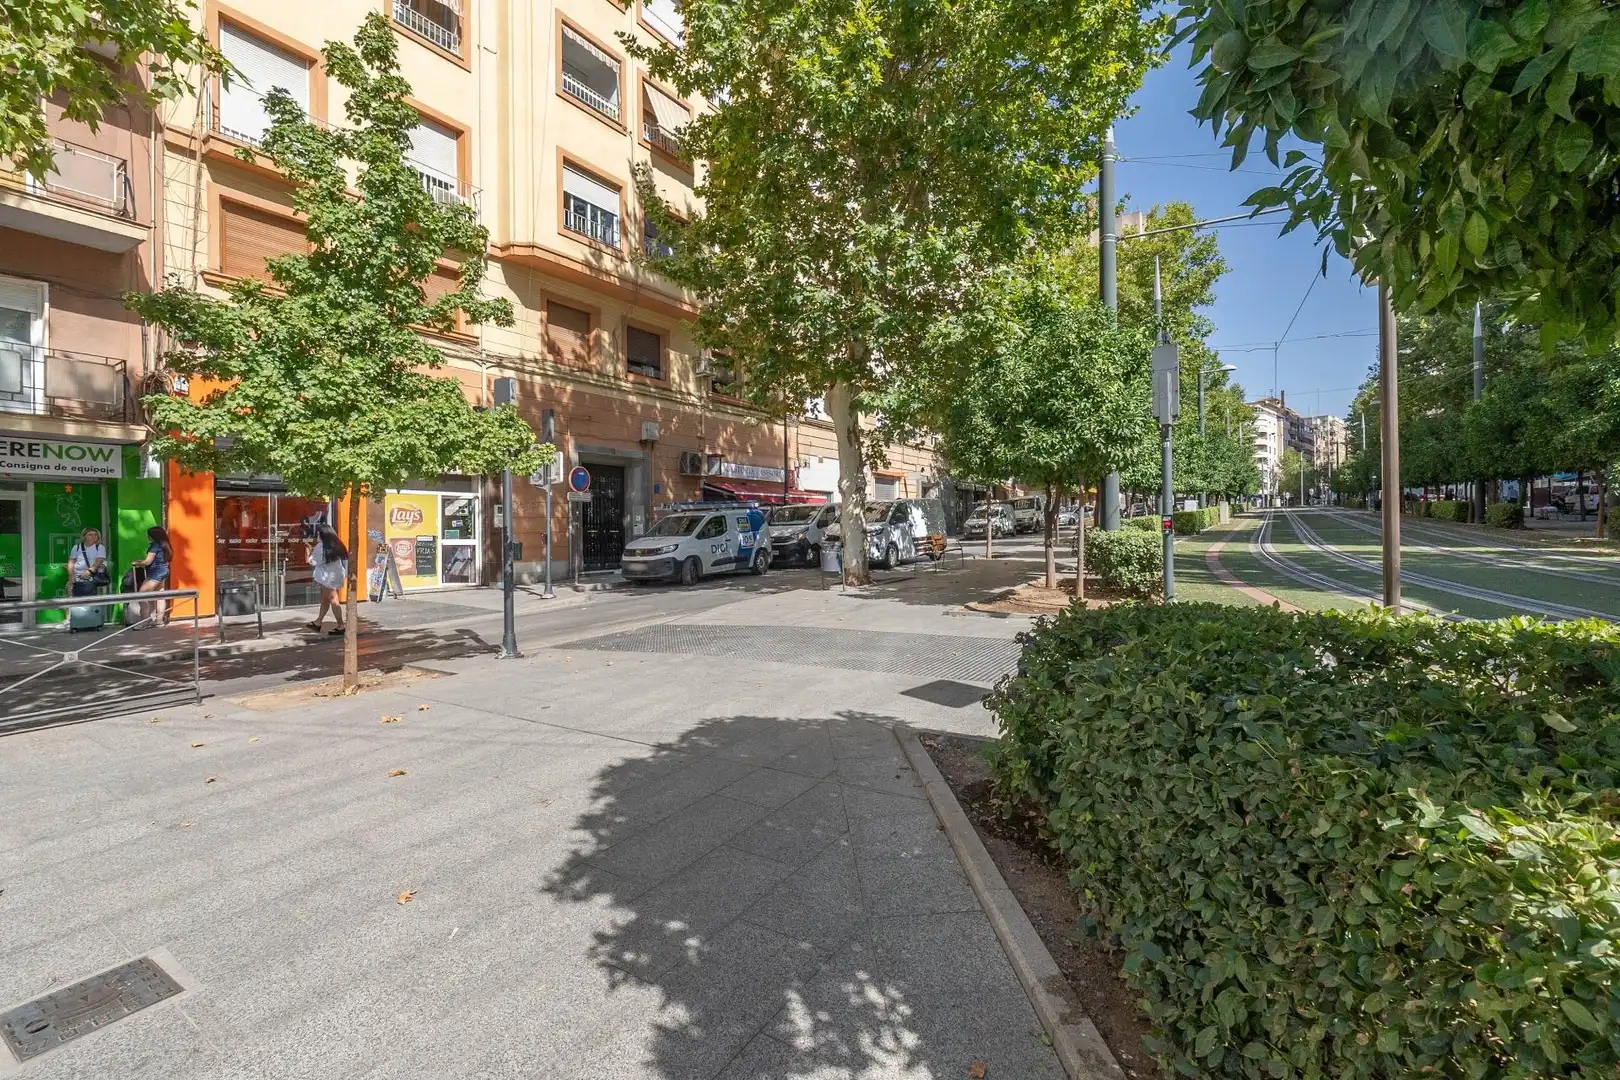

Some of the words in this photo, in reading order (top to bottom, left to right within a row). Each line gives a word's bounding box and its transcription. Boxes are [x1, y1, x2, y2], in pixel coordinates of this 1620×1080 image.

[0, 461, 50, 471] Consigna
[54, 463, 67, 471] de
[71, 465, 115, 474] equipaje
[391, 507, 421, 526] Lay's
